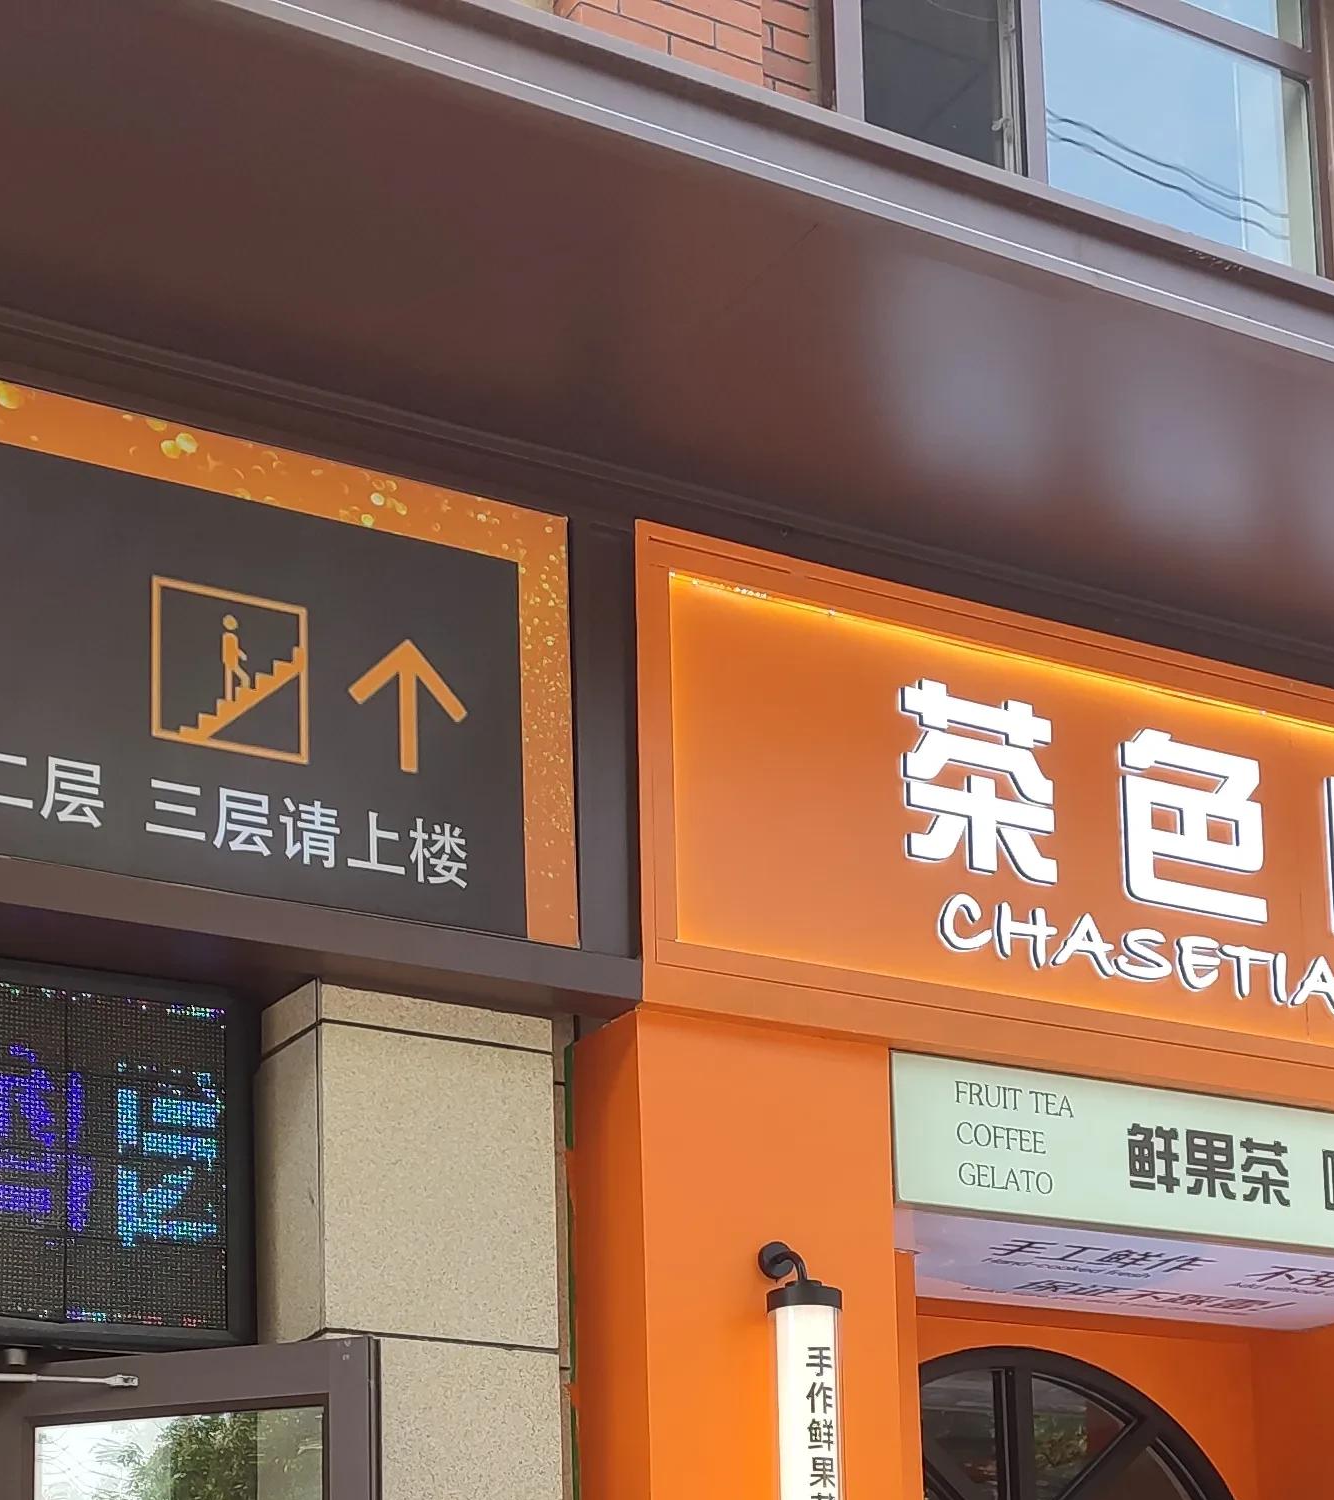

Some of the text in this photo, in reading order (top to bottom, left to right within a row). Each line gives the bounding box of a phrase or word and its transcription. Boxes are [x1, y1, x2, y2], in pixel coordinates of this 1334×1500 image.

[145, 777, 468, 889] 三层请上楼
[954, 1080, 1074, 1119] FRUIT TEA
[956, 1121, 1047, 1156] COFFEE
[957, 1162, 1054, 1196] GELATO
[1127, 1122, 1291, 1208] 鲜果茶
